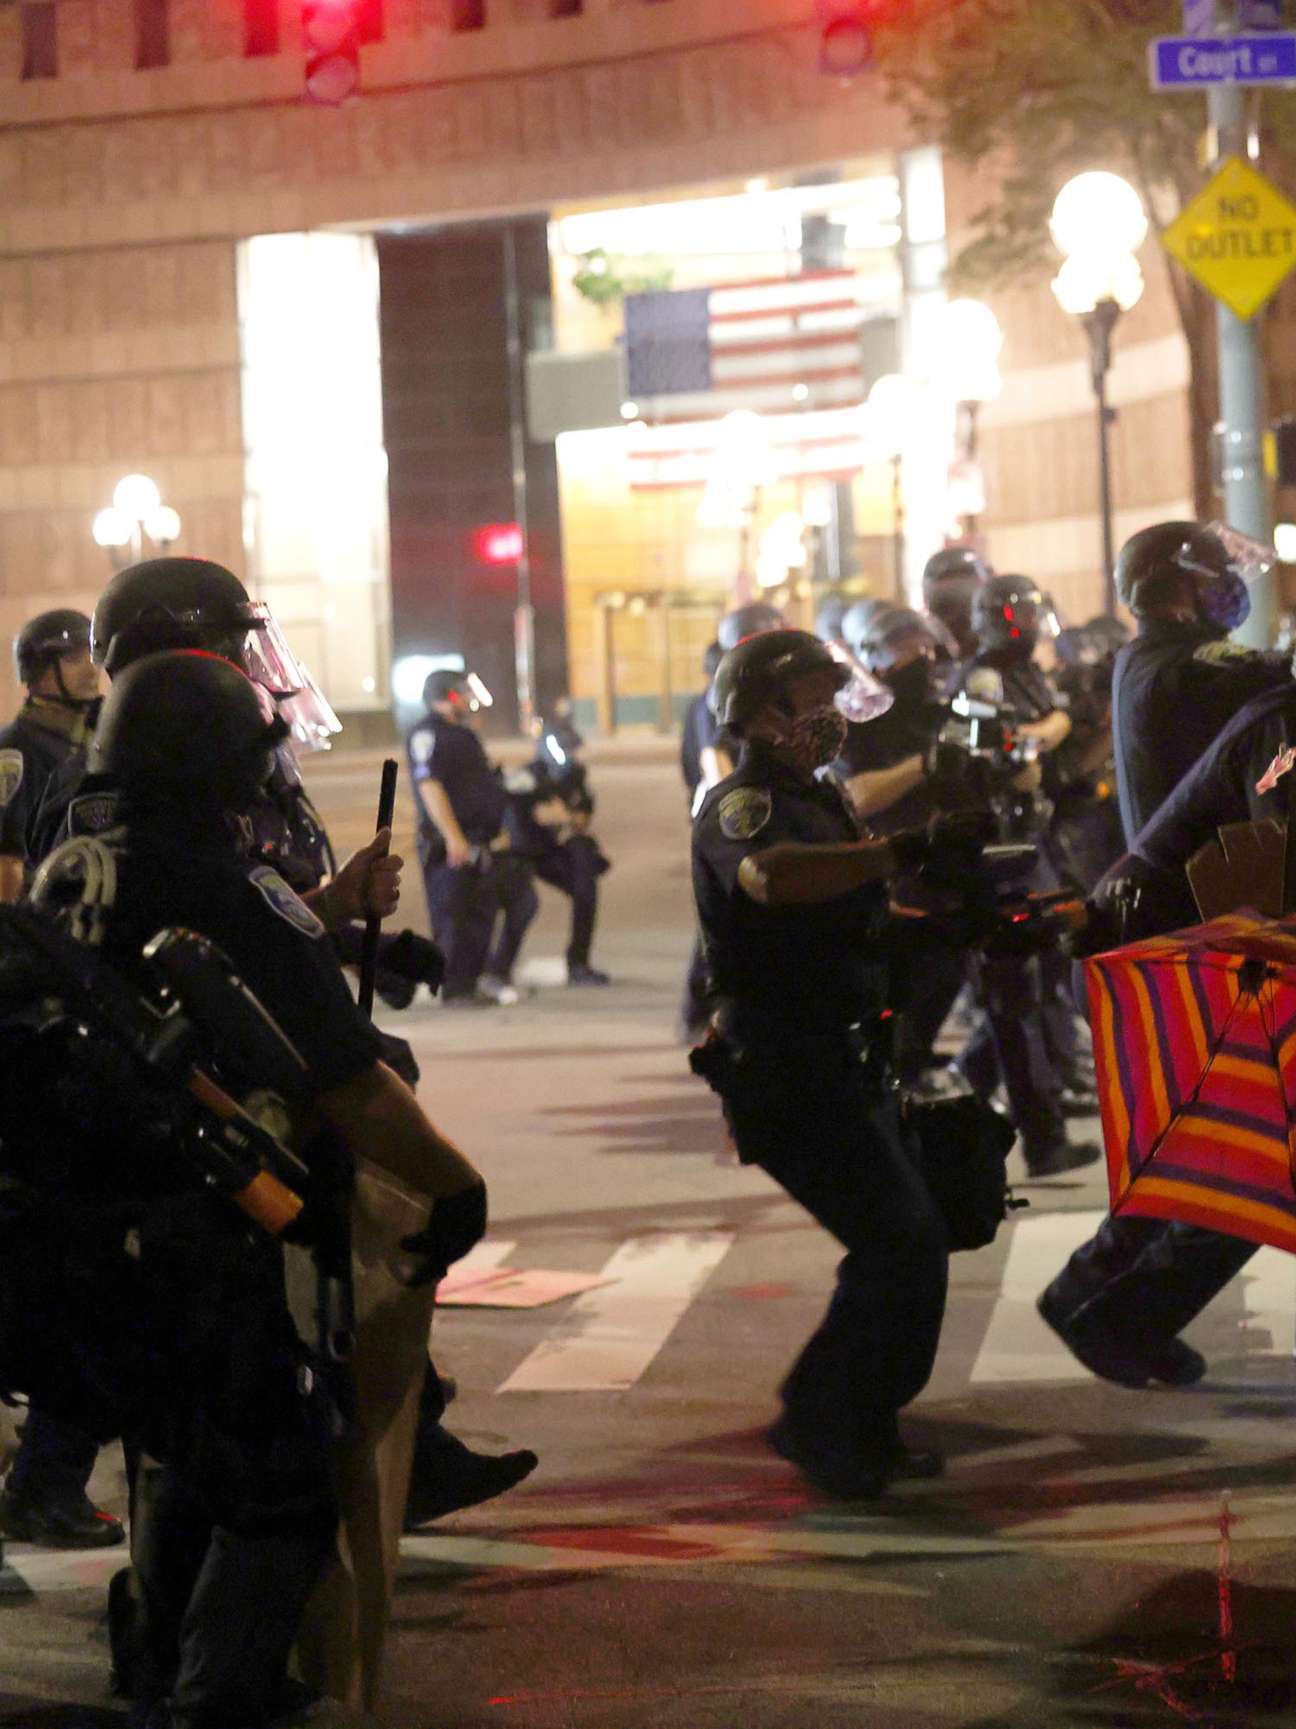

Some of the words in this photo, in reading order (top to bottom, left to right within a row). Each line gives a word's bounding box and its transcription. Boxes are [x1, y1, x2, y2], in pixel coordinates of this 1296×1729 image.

[1178, 46, 1250, 76] Court
[1219, 196, 1258, 219] NO
[1187, 229, 1293, 259] OUTLET
